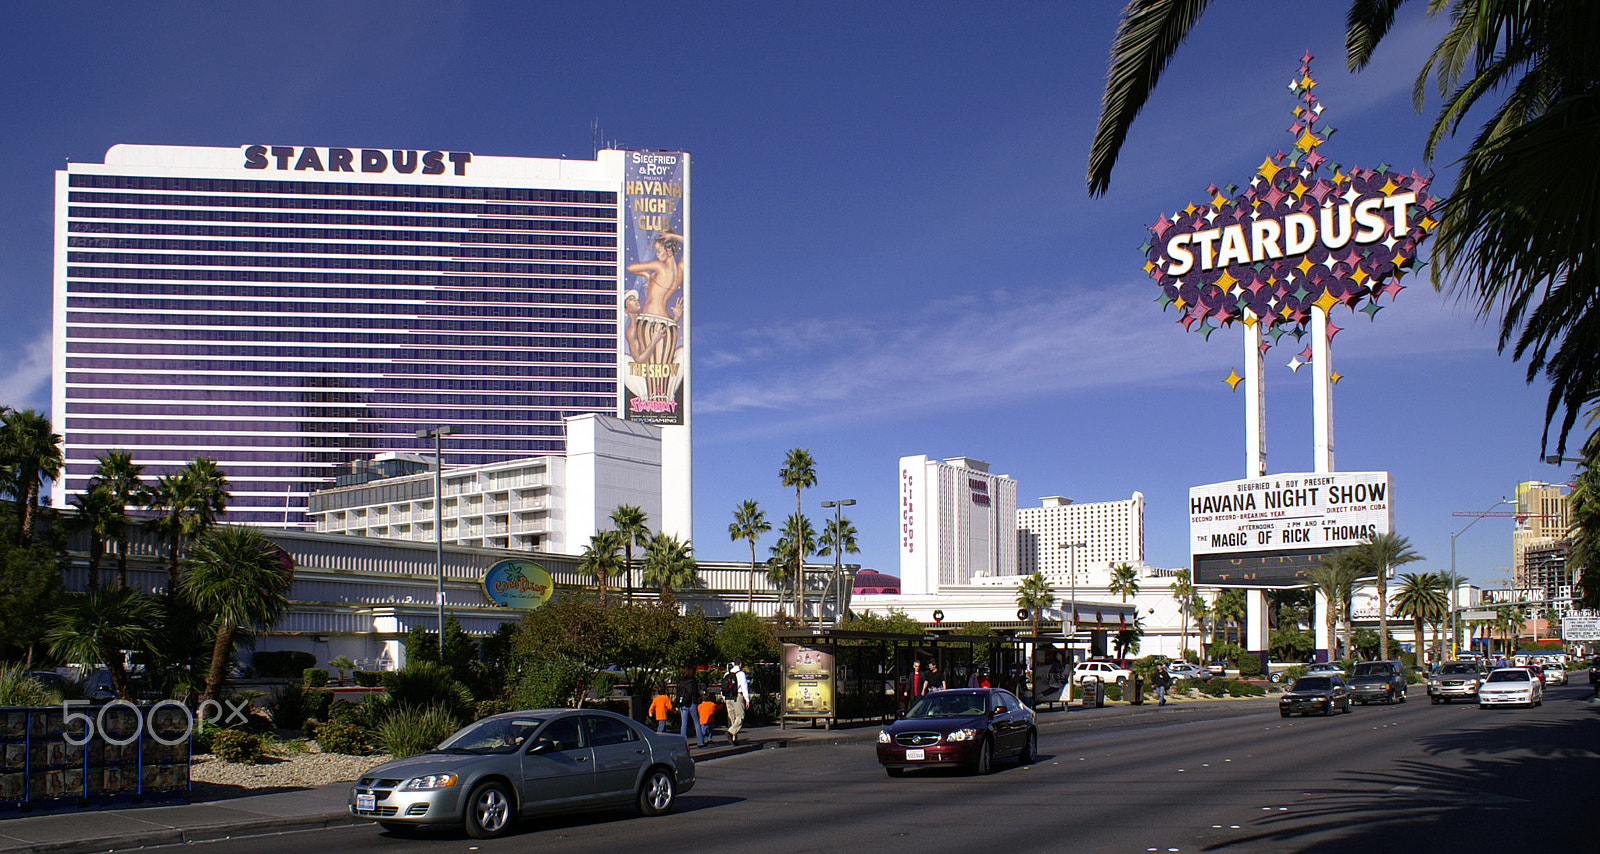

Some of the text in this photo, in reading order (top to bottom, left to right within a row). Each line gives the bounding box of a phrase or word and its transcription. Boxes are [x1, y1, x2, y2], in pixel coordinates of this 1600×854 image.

[244, 144, 472, 176] STARDUST
[632, 152, 677, 165] SIEGFRIED
[626, 180, 682, 199] HAVANA
[634, 197, 675, 214] NIGHT
[638, 215, 670, 231] CLUB
[1165, 192, 1417, 276] STARDUST
[629, 362, 680, 377] THE SHOW
[1237, 476, 1336, 492] SIEGFRIED & ROY PRESENT
[1191, 482, 1387, 515] HAVANA NIGHT SHOW
[1191, 515, 1213, 523] SECOND
[1270, 510, 1286, 518] YEAR
[1326, 506, 1348, 514] DIRECT
[1369, 503, 1386, 511] CUBA
[1237, 523, 1275, 531] AFTERNOONS
[1211, 532, 1248, 548] MAGIC
[1257, 530, 1273, 545] OF
[1282, 528, 1311, 544] RICK
[1323, 523, 1377, 542] THOMAS
